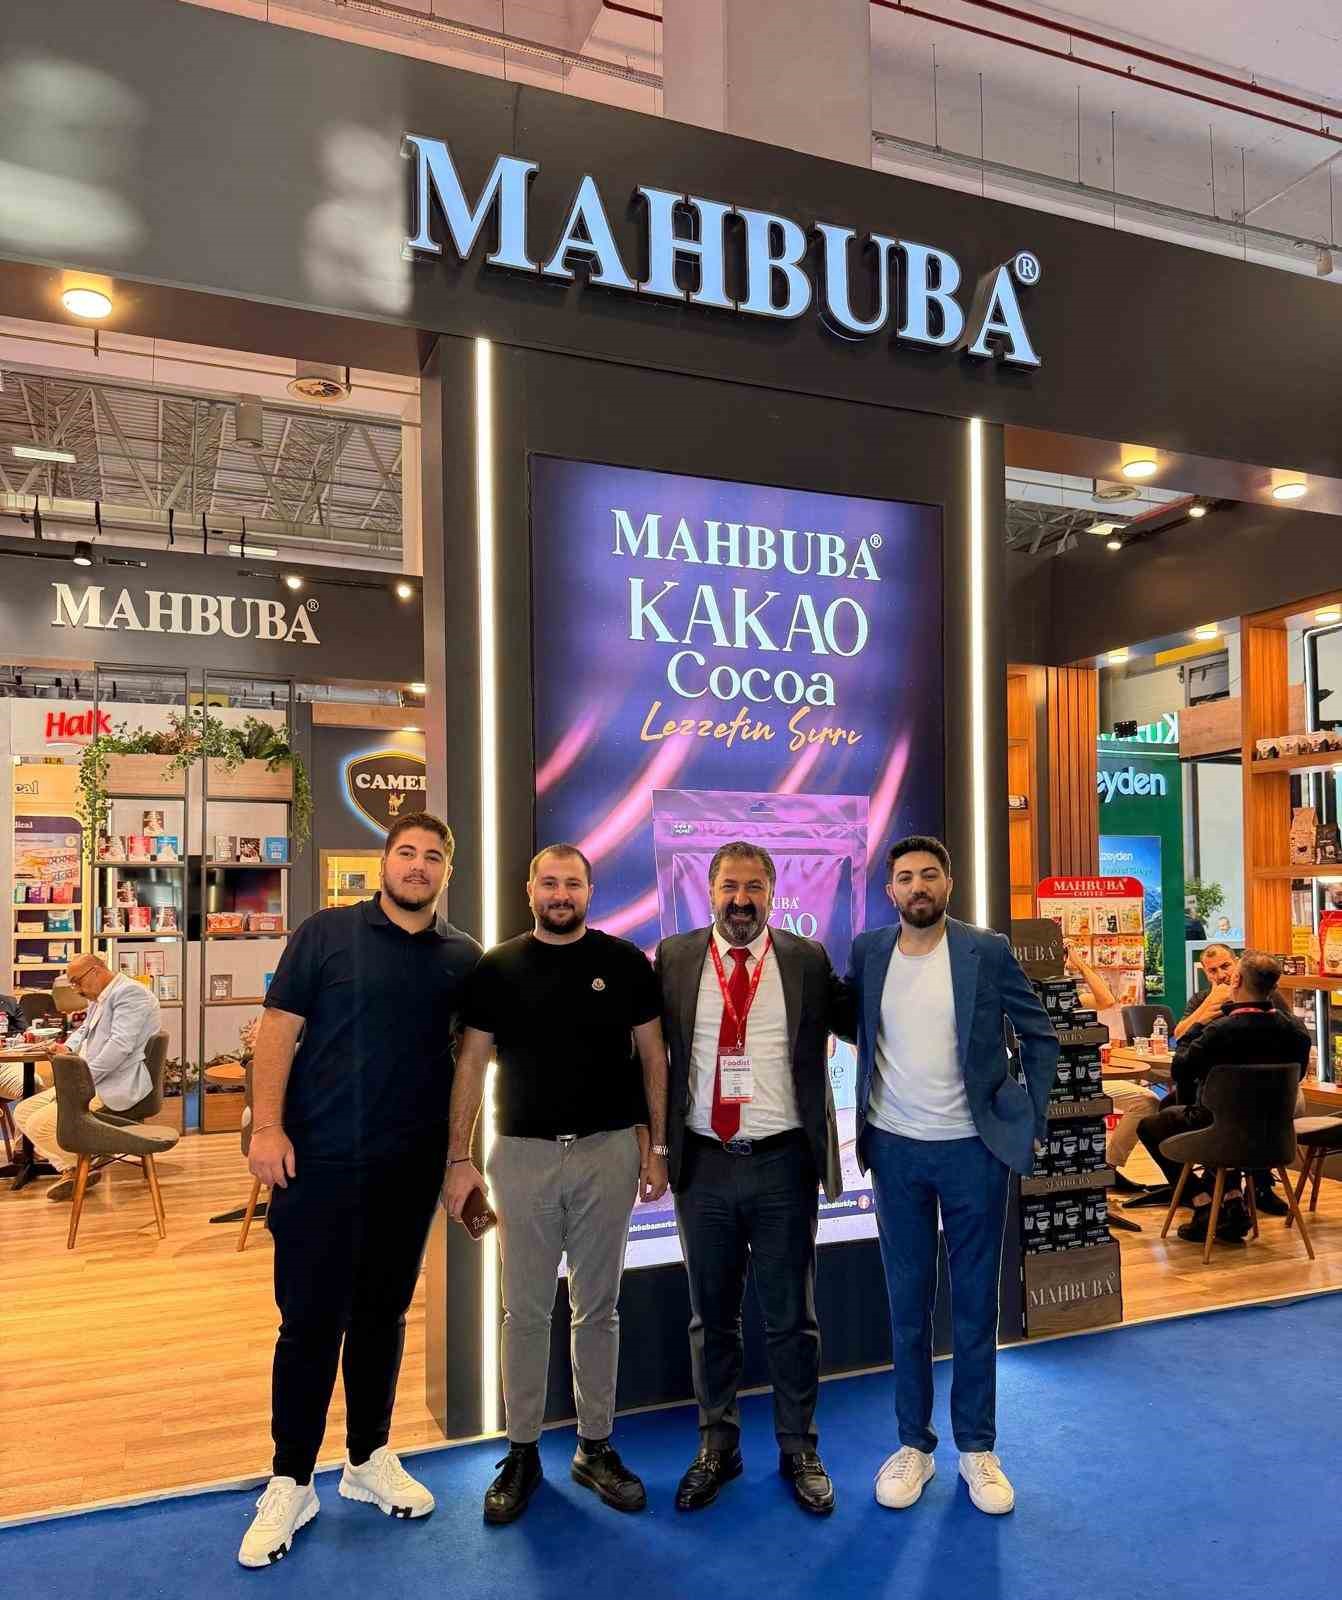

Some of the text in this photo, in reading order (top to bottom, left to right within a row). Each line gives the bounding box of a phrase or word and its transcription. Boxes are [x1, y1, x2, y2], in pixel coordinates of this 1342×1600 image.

[628, 576, 869, 657] KAKAO
[667, 650, 836, 706] Cocoa
[46, 709, 112, 737] Halk
[640, 700, 775, 748] Lezzetin
